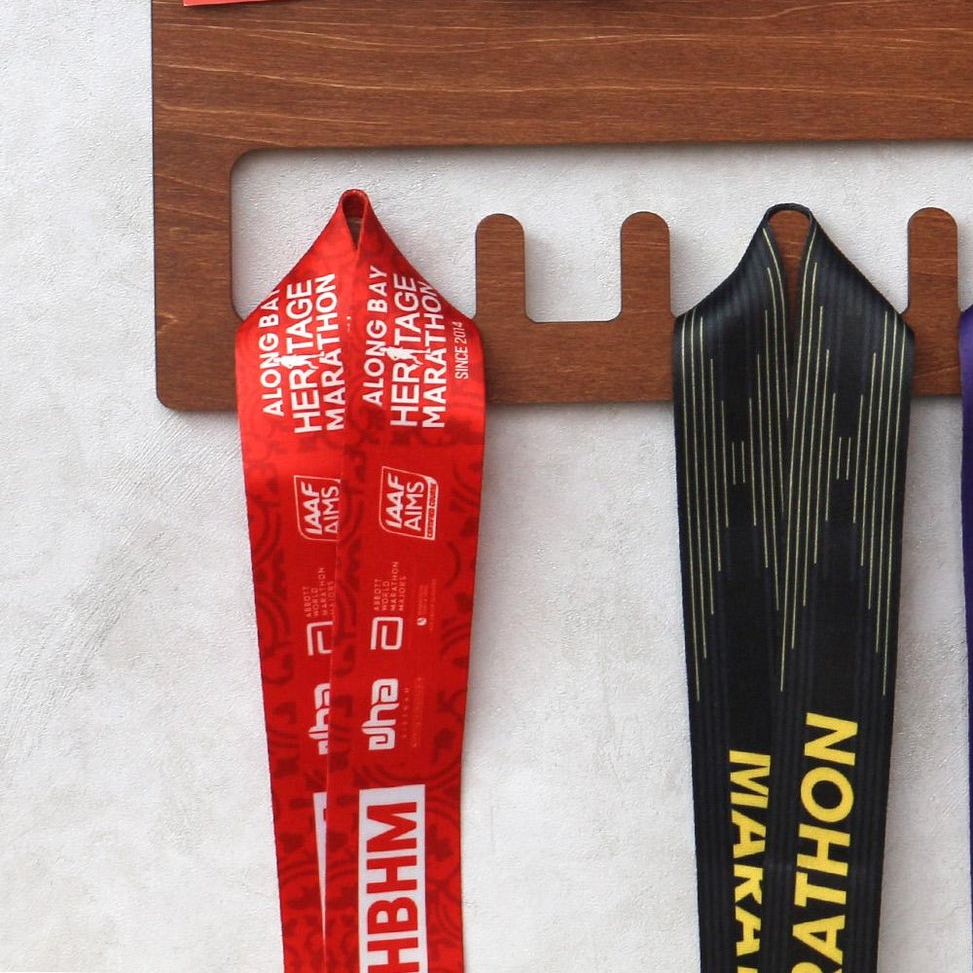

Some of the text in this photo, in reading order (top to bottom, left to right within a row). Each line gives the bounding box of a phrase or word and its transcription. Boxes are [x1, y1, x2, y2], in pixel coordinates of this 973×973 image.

[315, 273, 345, 431] MARATHON
[362, 265, 388, 407] ALONG BAY
[415, 281, 447, 428] MARATHON
[452, 321, 469, 380] SINCE 2014
[259, 331, 285, 416] ALONG
[300, 481, 323, 535] IAAF
[320, 485, 341, 535] AIMS
[385, 473, 407, 529] IAAF
[403, 481, 425, 532] AIMS
[390, 561, 399, 611] MARATHON
